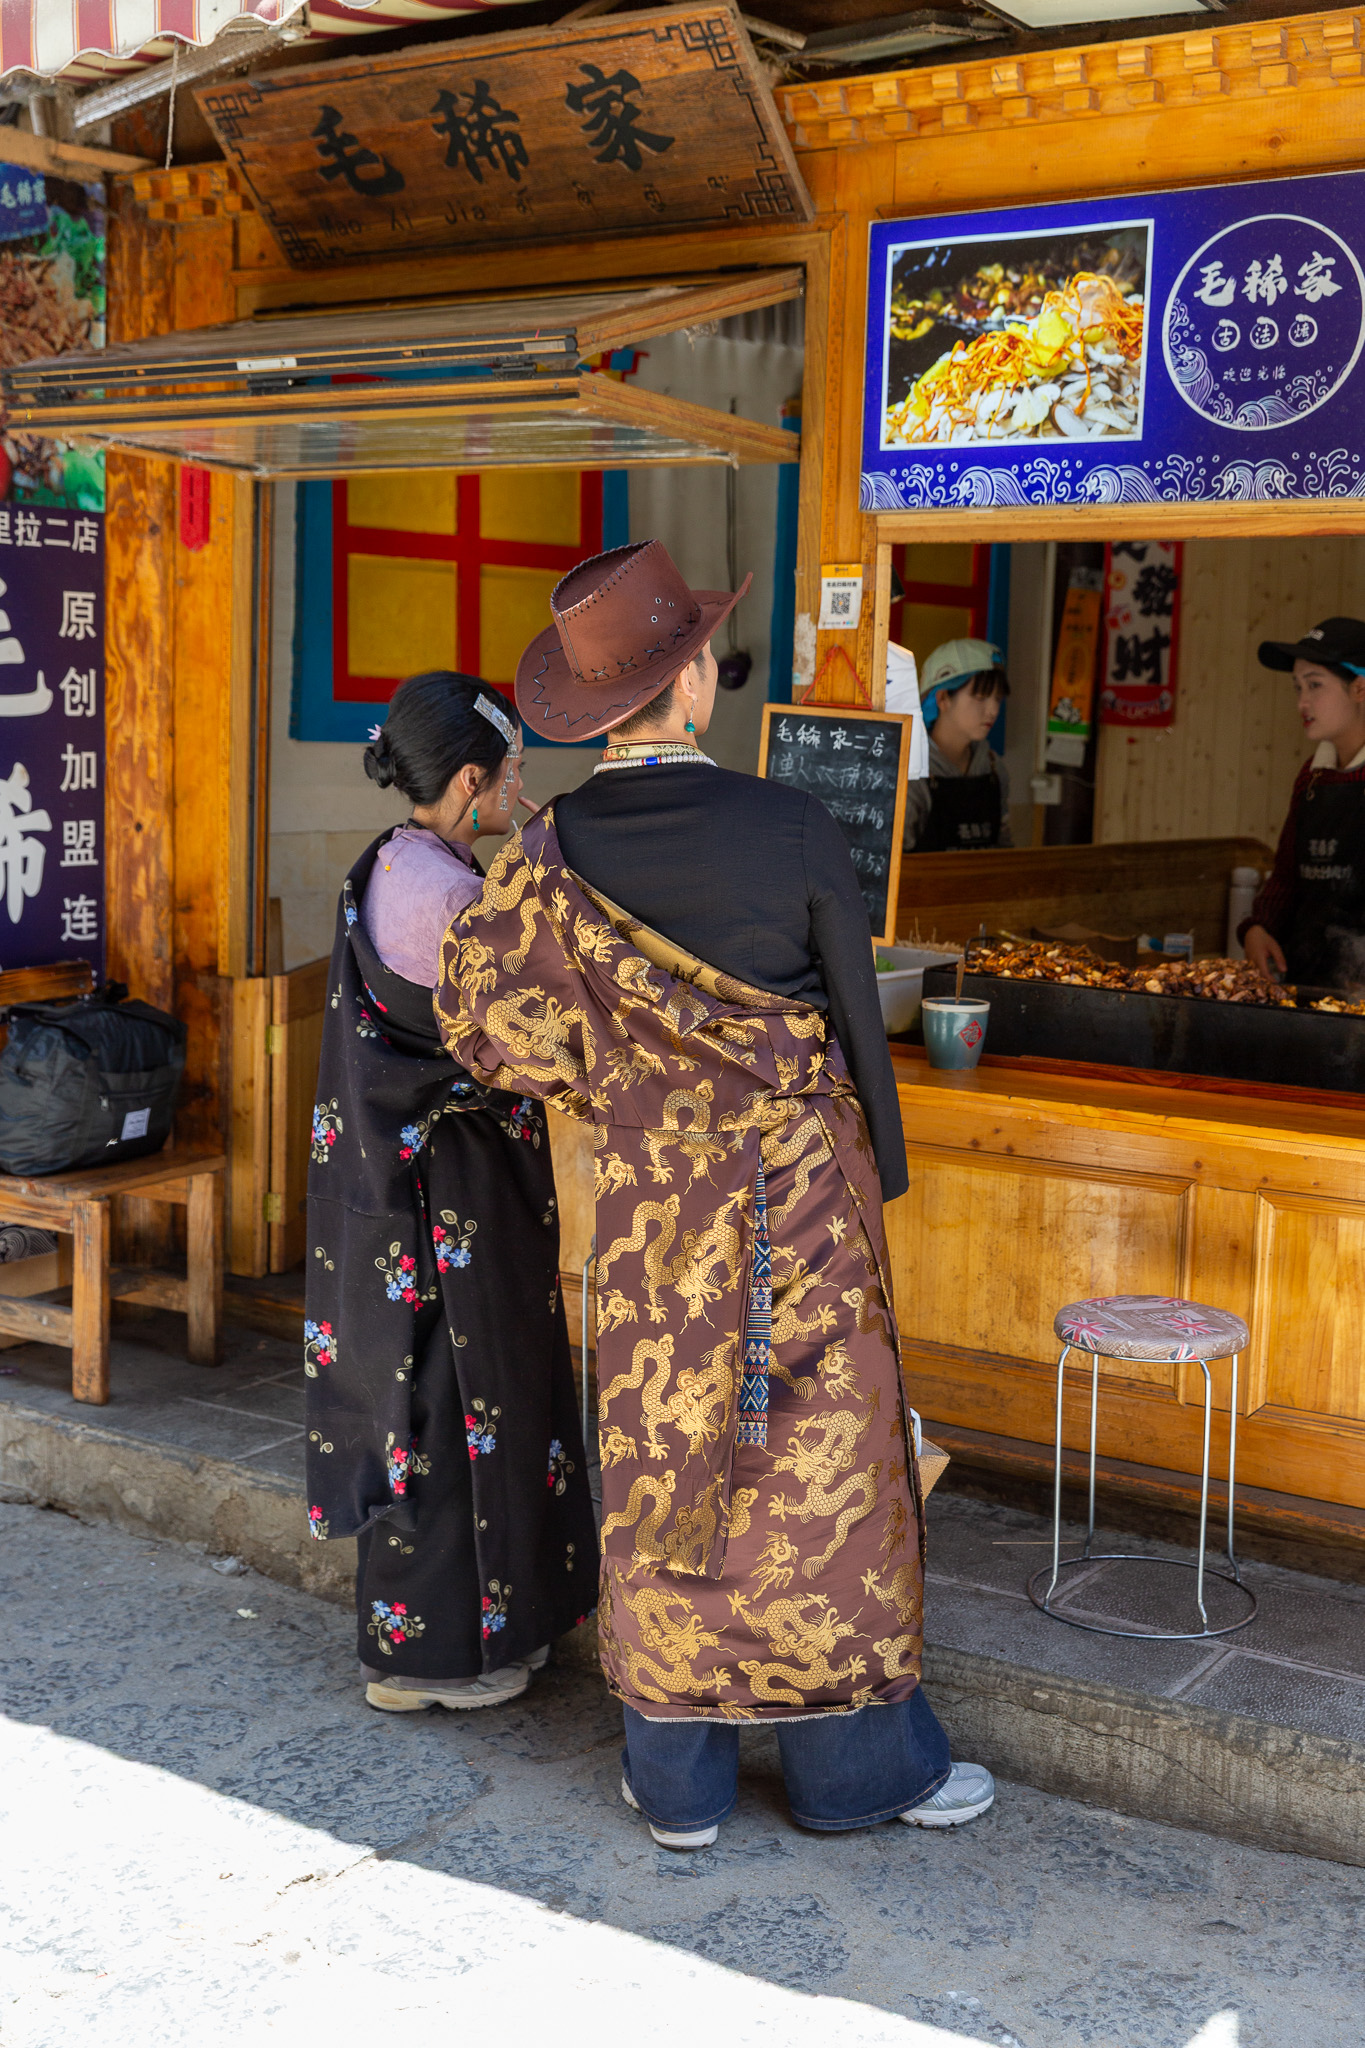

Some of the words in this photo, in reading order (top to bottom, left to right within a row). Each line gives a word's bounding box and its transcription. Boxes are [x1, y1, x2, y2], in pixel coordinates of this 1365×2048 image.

[310, 62, 676, 197] 毛稀家
[317, 212, 362, 238] Mao
[443, 199, 487, 225] Jia
[1193, 250, 1343, 307] 毛稀家
[58, 590, 99, 990] 原创加盟连
